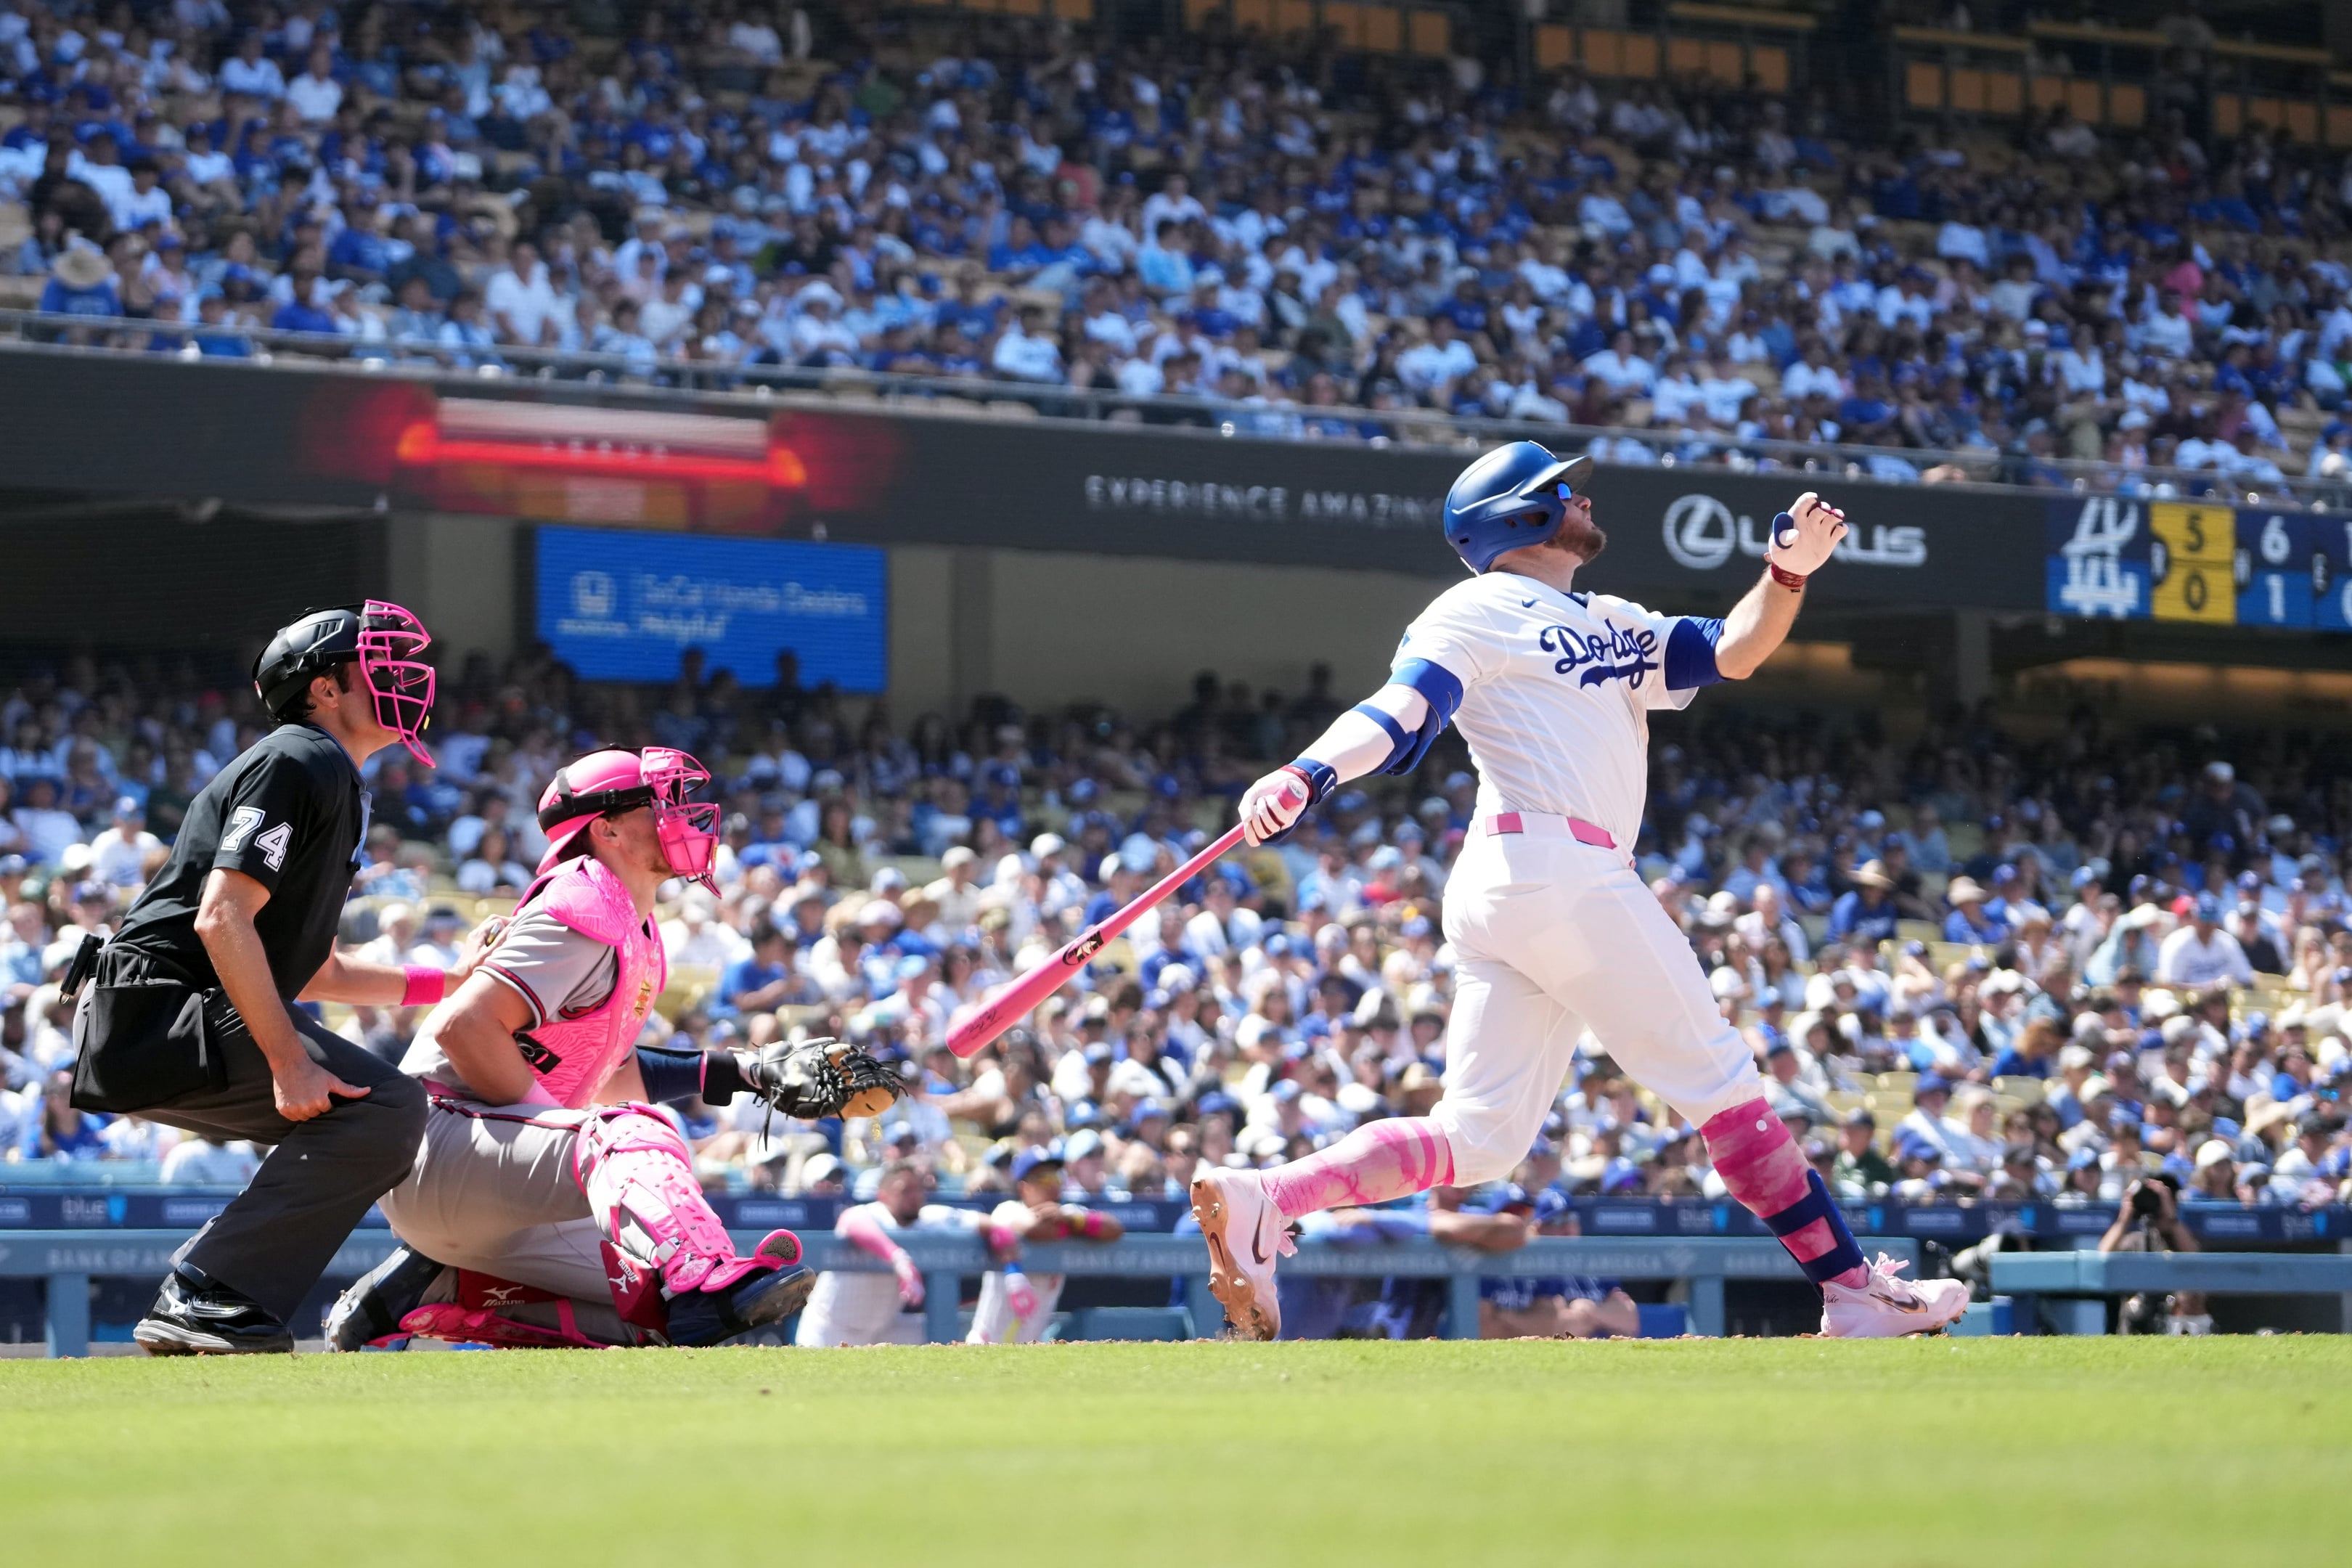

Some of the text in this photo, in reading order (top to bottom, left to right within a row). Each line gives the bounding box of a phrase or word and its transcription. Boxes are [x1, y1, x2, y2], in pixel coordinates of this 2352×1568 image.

[1085, 475, 1289, 517] EXPERIENCE
[1737, 515, 1927, 567] LUS
[2184, 513, 2204, 552] 5
[2261, 515, 2290, 564] 6
[2184, 572, 2208, 611] 0
[2266, 575, 2285, 623] 1
[221, 806, 293, 872] 74
[1142, 1251, 1211, 1270] AMERIC
